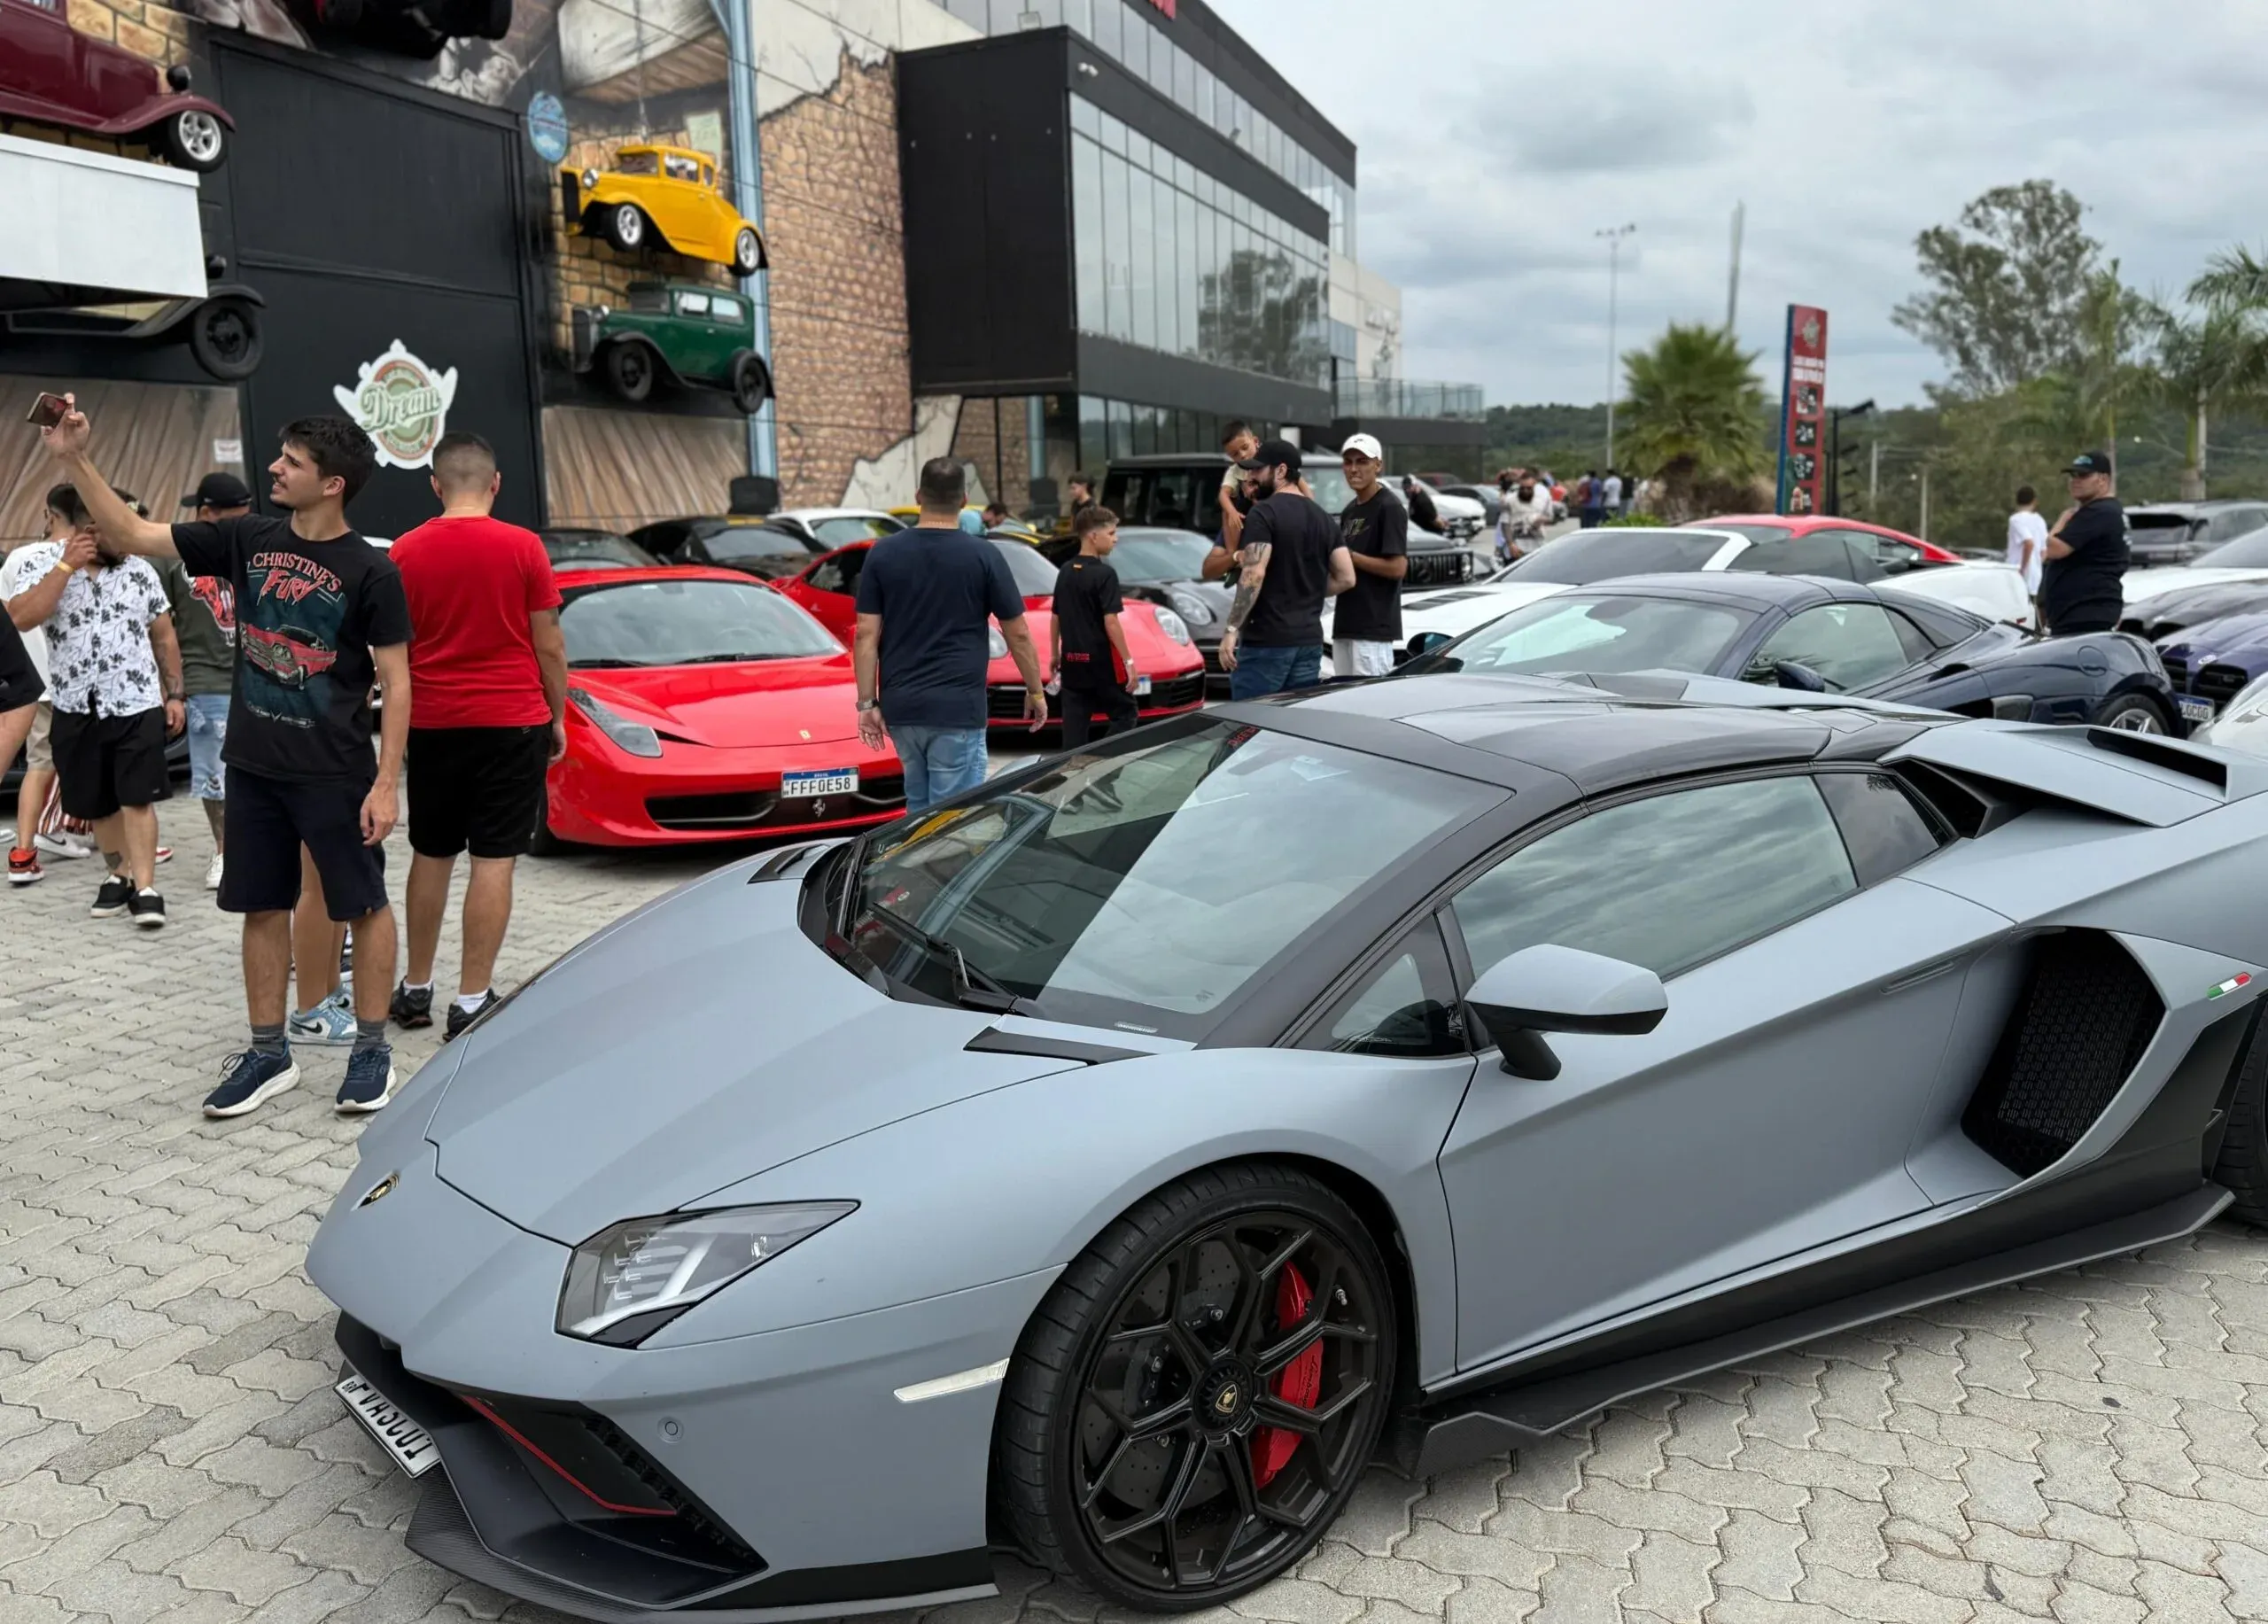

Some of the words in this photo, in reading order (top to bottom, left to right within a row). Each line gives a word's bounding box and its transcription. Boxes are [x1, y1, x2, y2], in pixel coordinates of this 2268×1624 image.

[360, 384, 441, 432] Dream
[252, 552, 342, 592] CHRISTINE'S
[790, 776, 851, 795] FFF0E58
